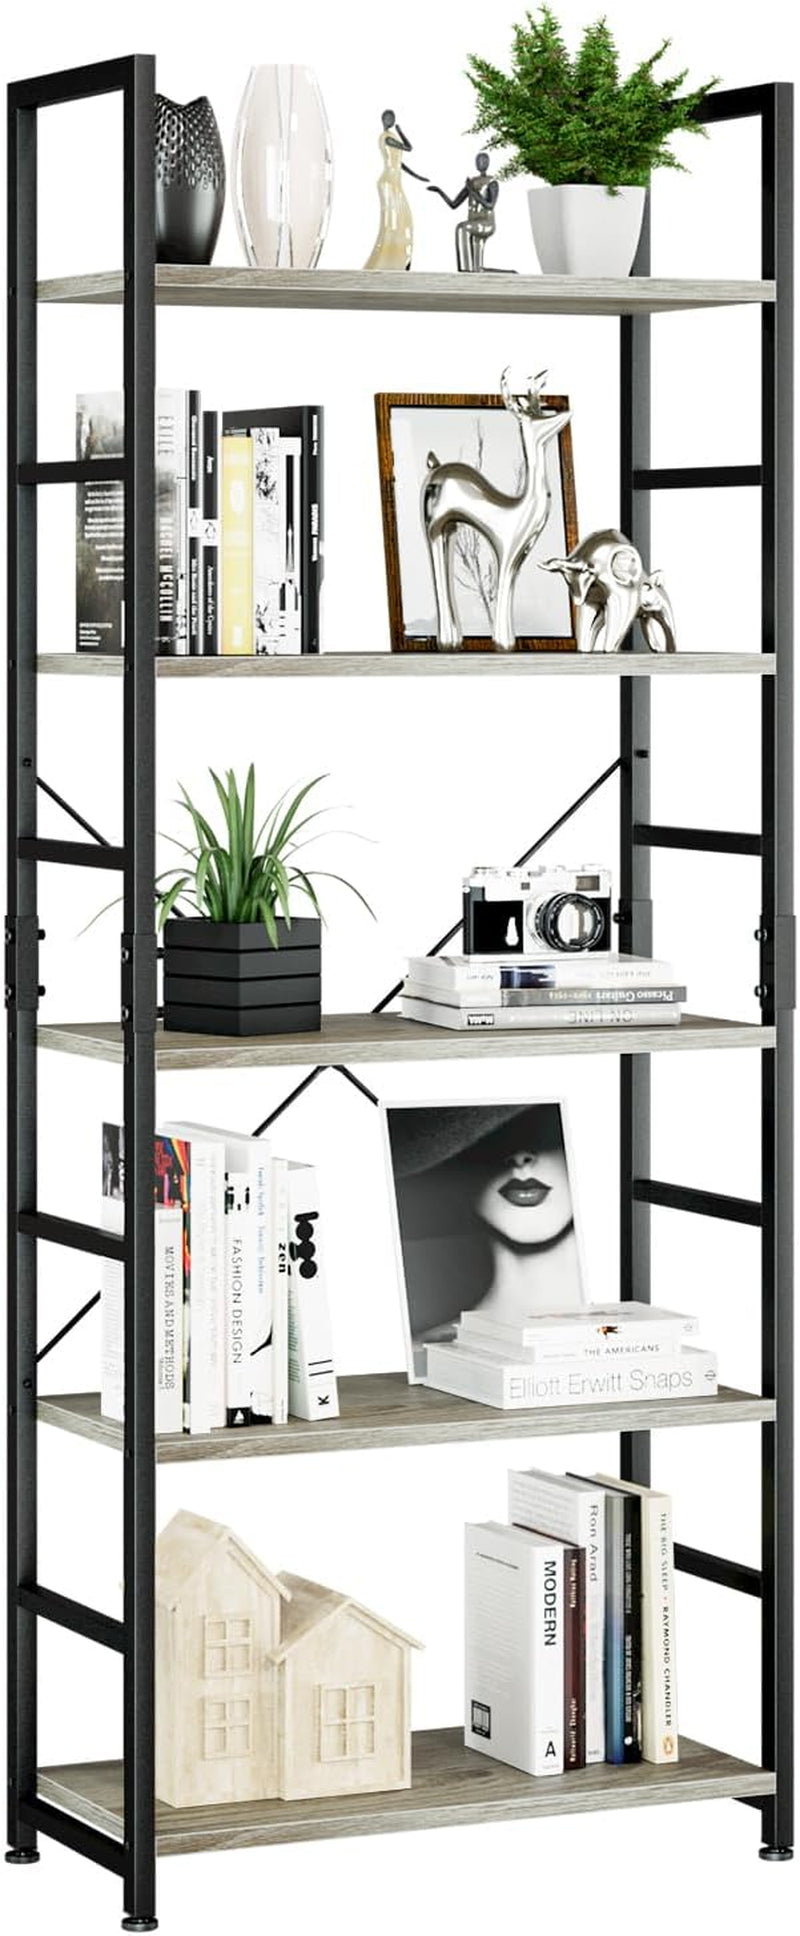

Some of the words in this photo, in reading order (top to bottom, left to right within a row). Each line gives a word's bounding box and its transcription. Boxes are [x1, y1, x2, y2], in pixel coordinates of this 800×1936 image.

[158, 416, 175, 455] EXILE
[636, 990, 674, 1002] Picasso
[164, 1246, 175, 1298] MOVIES
[232, 1238, 242, 1304] FASHION
[278, 1242, 287, 1274] zen
[164, 1301, 175, 1327] AND
[232, 1309, 242, 1364] DESIGN
[584, 1347, 601, 1357] THE
[604, 1343, 660, 1356] AMERICANS
[164, 1330, 176, 1390] METHODS
[509, 1375, 561, 1399] Elliott
[568, 1372, 622, 1396] Erwitt
[629, 1368, 693, 1395] Snaps
[589, 1504, 598, 1538] Ron
[659, 1512, 667, 1534] THE
[588, 1544, 598, 1582] Arad
[660, 1560, 669, 1591] SLEEP
[543, 1560, 557, 1647] MODERN
[662, 1606, 671, 1664] RAYMOND
[663, 1668, 672, 1727] CHANDLER
[545, 1740, 556, 1758] A
